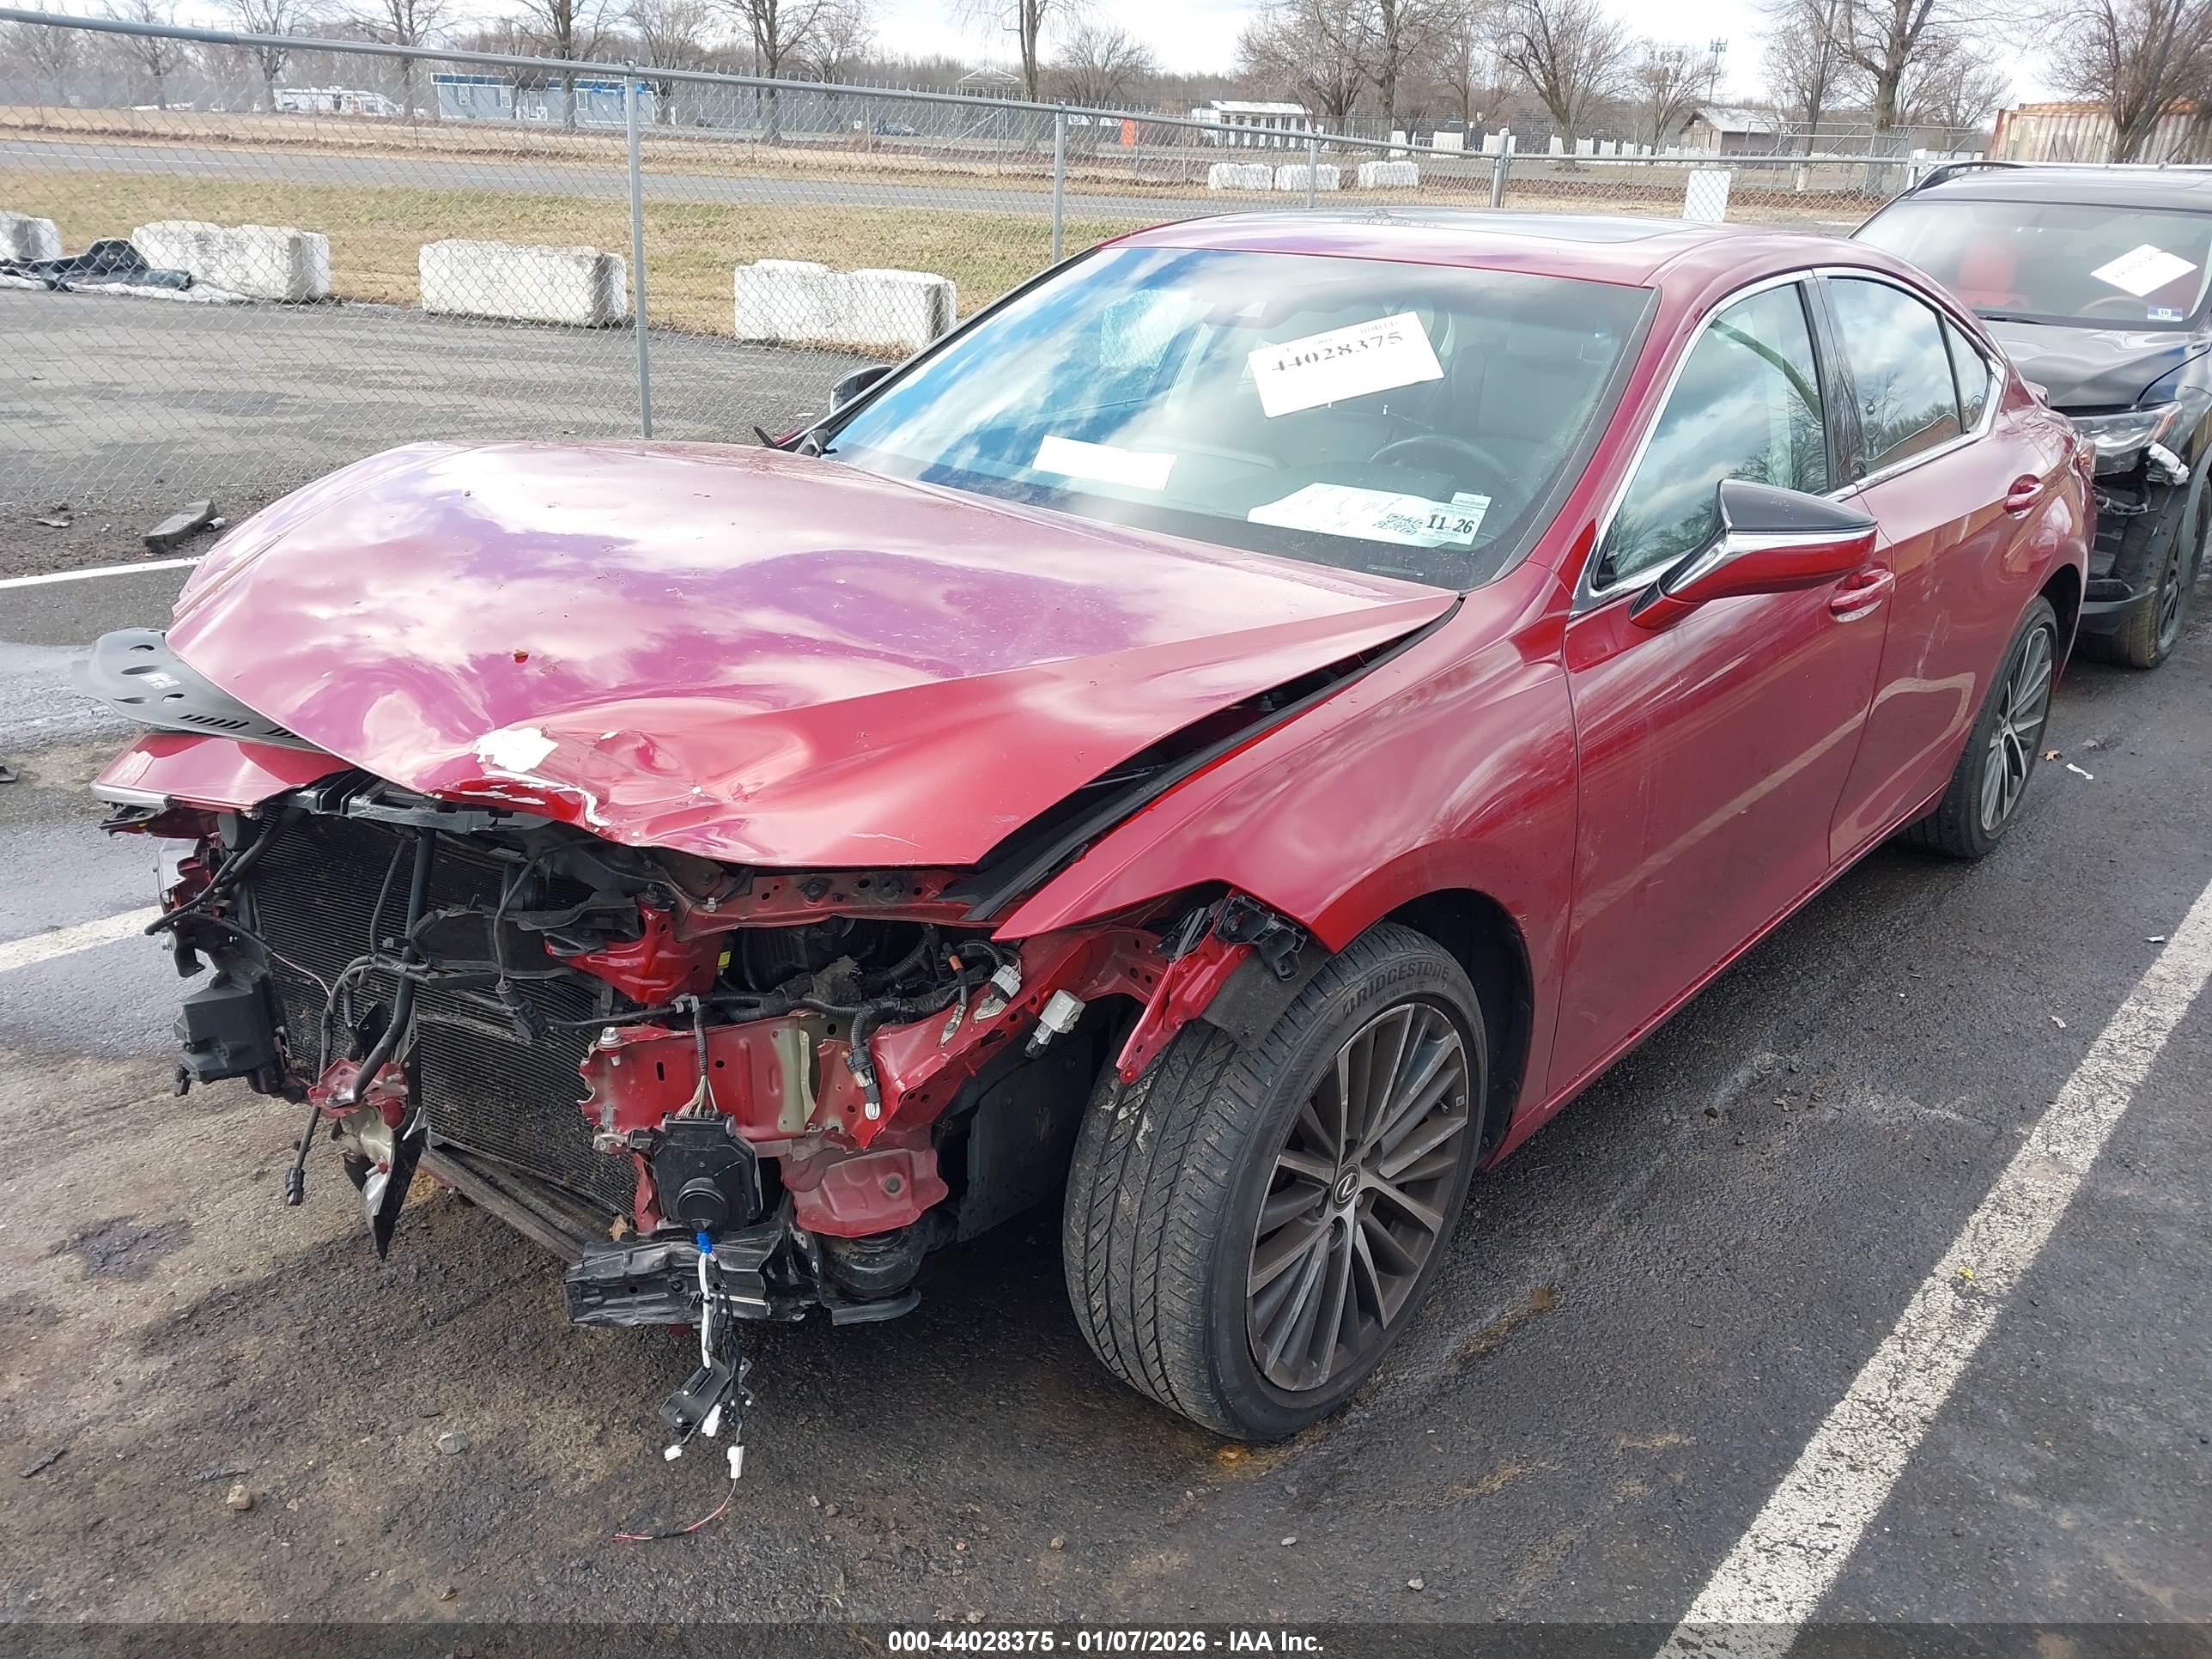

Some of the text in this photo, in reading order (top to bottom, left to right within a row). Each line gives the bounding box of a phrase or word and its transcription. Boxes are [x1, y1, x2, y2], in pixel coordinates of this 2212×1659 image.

[1426, 514, 1449, 530] 11
[1453, 518, 1475, 534] 26
[1341, 960, 1450, 1020] BRIDGESTONE
